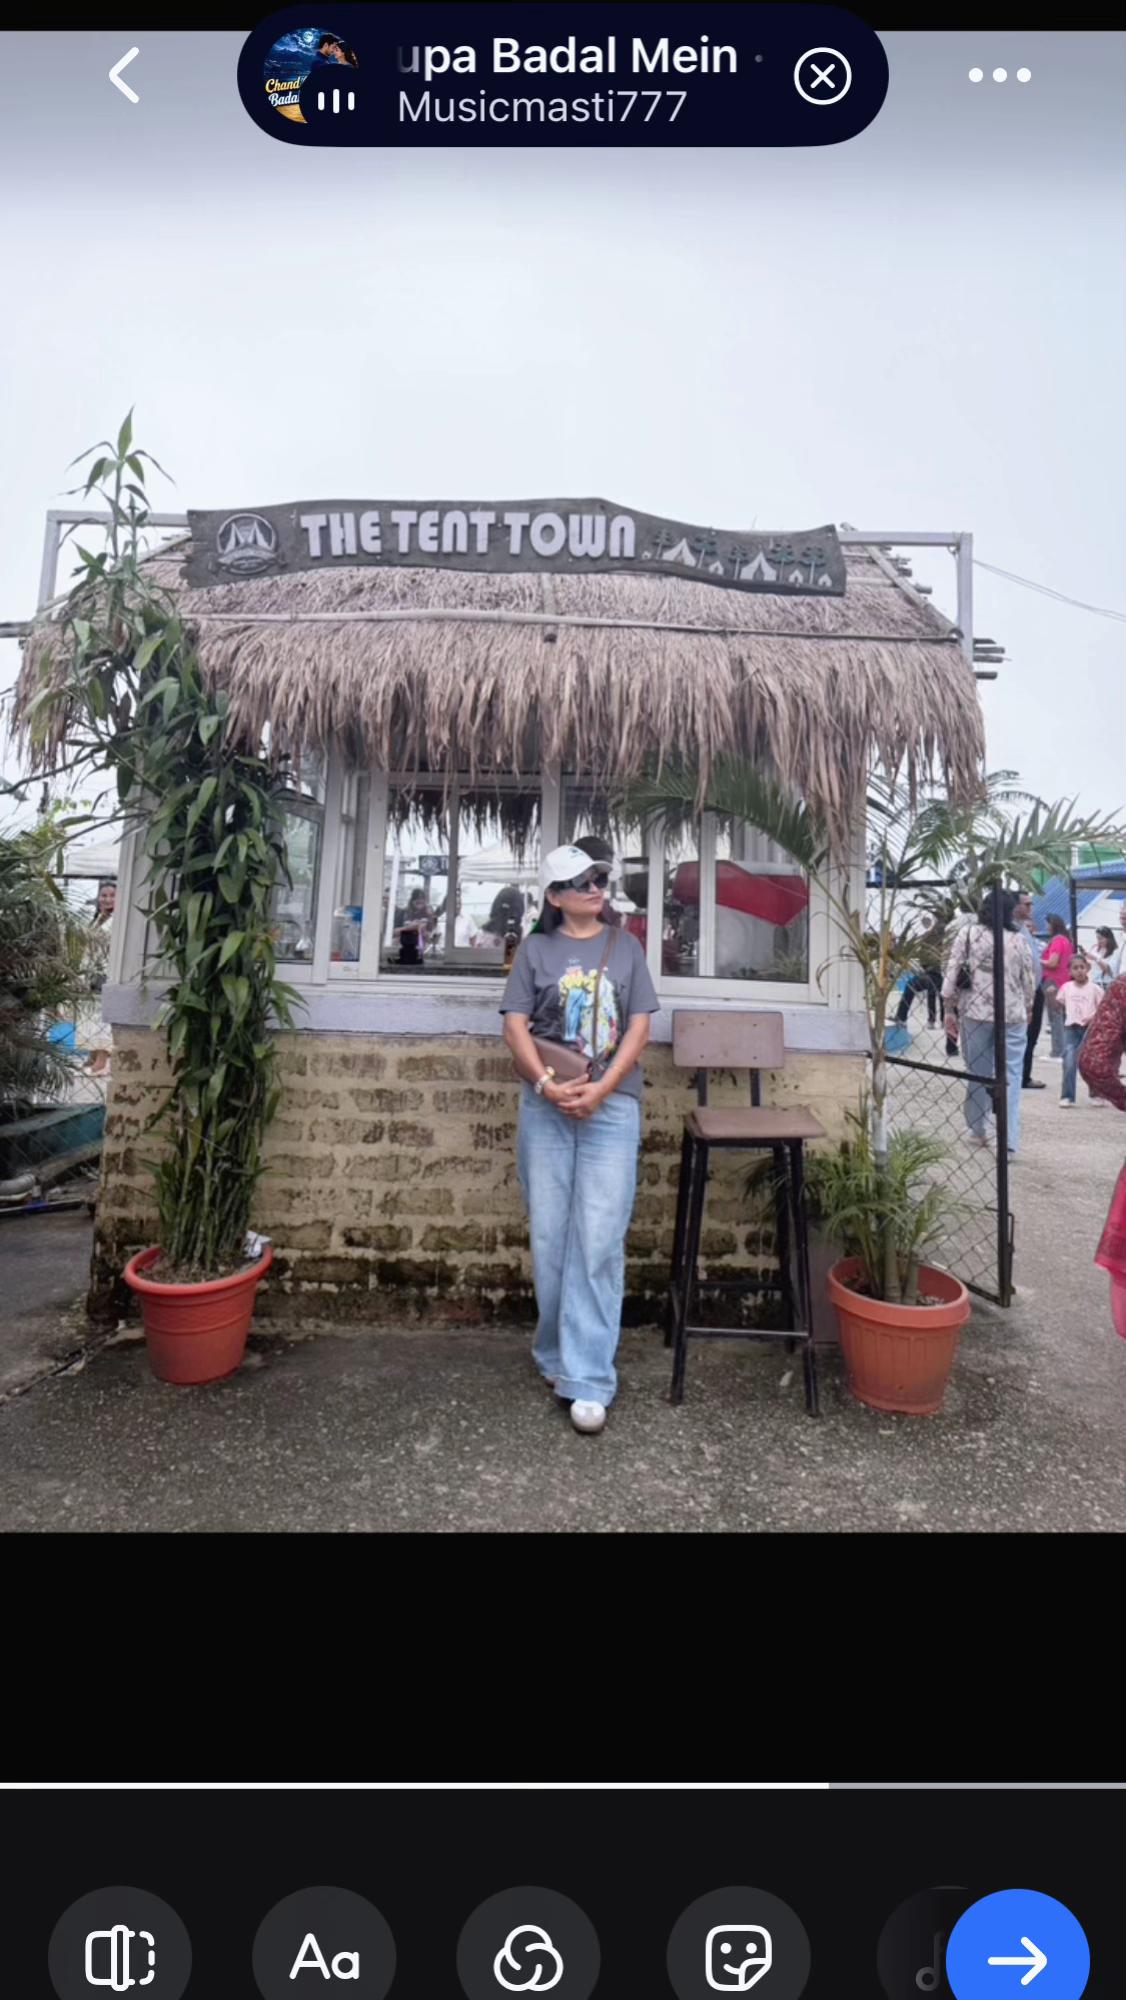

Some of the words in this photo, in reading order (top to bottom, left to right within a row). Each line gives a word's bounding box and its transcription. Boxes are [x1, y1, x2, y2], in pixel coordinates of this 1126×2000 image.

[301, 511, 382, 557] THE
[391, 510, 495, 553] TENT
[504, 512, 636, 558] TOWN
